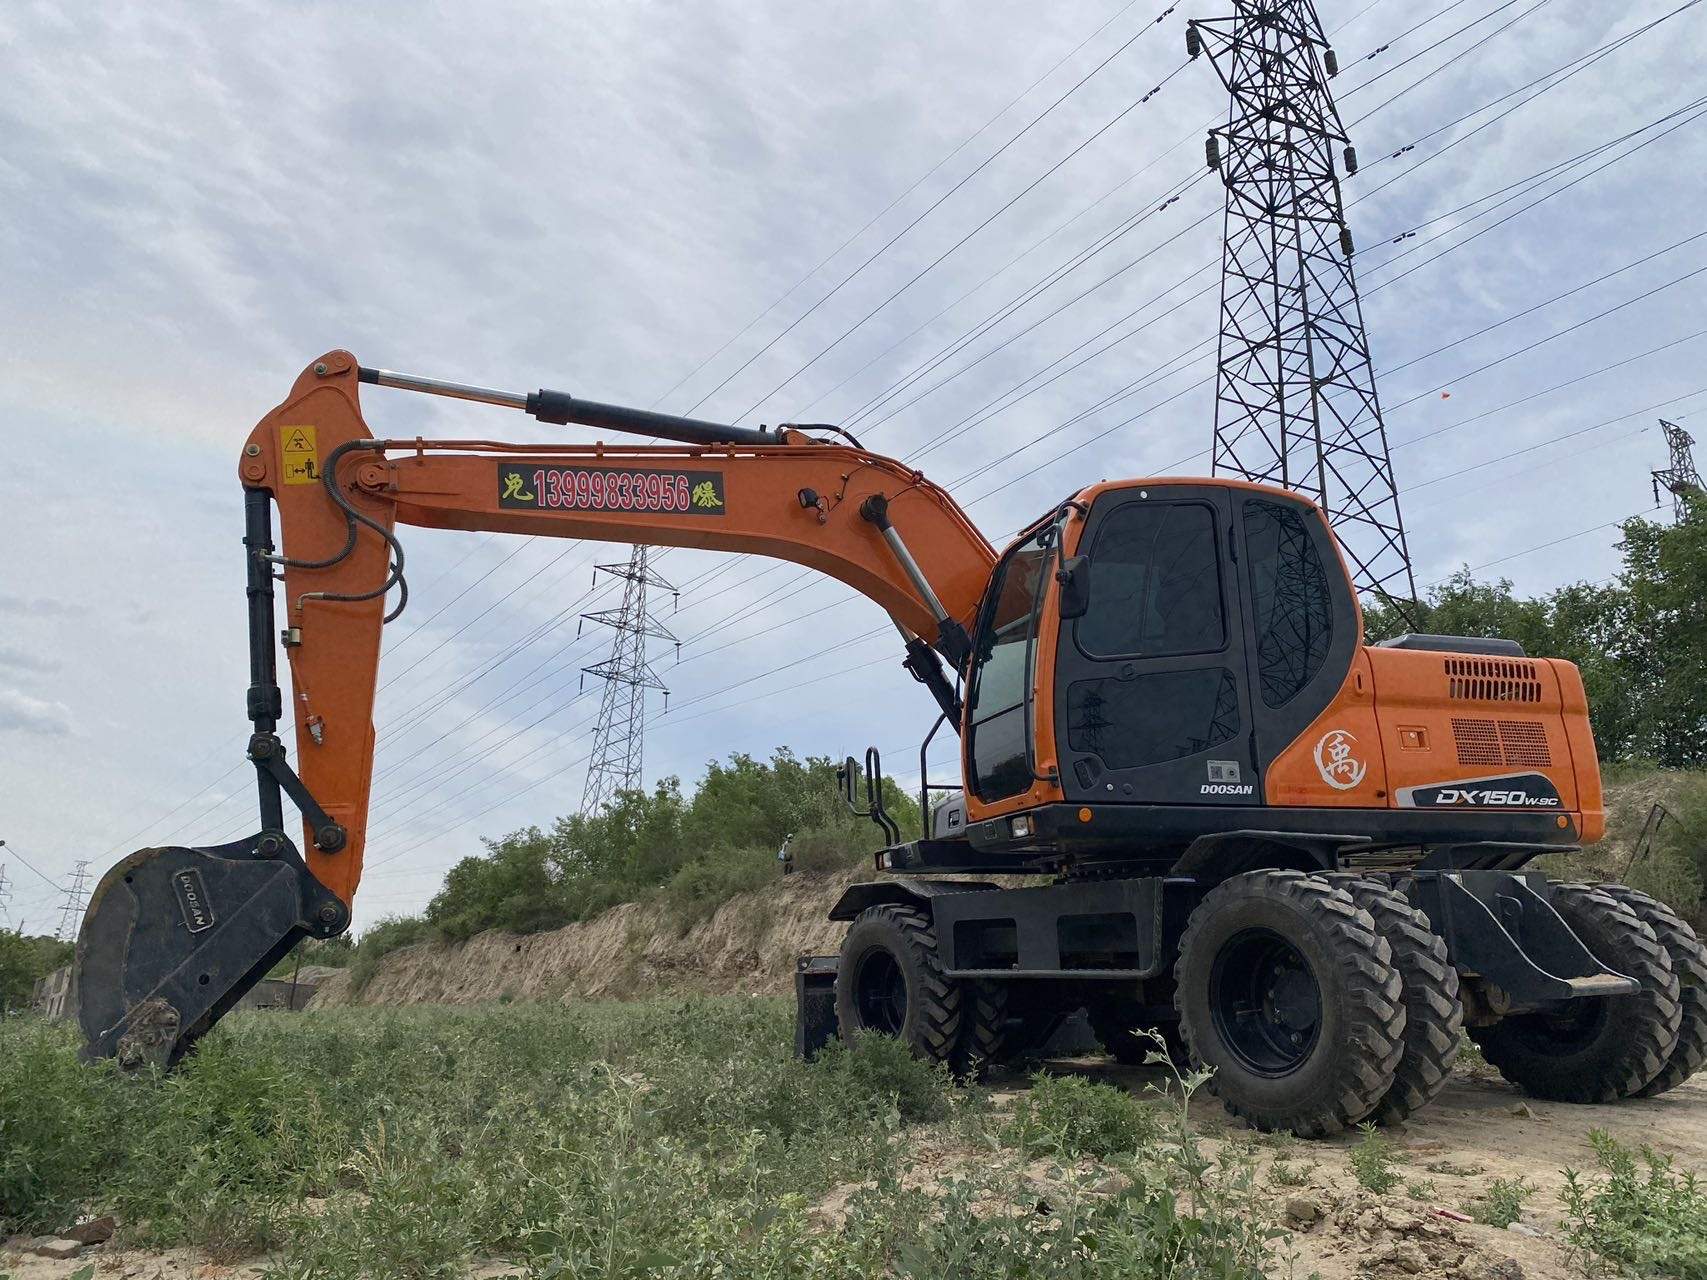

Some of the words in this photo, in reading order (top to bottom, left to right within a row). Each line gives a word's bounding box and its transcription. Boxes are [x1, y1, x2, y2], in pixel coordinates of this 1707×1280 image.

[533, 469, 690, 511] 13999833956
[1200, 784, 1253, 795] DOOSAN
[180, 875, 206, 925] DOOSAN
